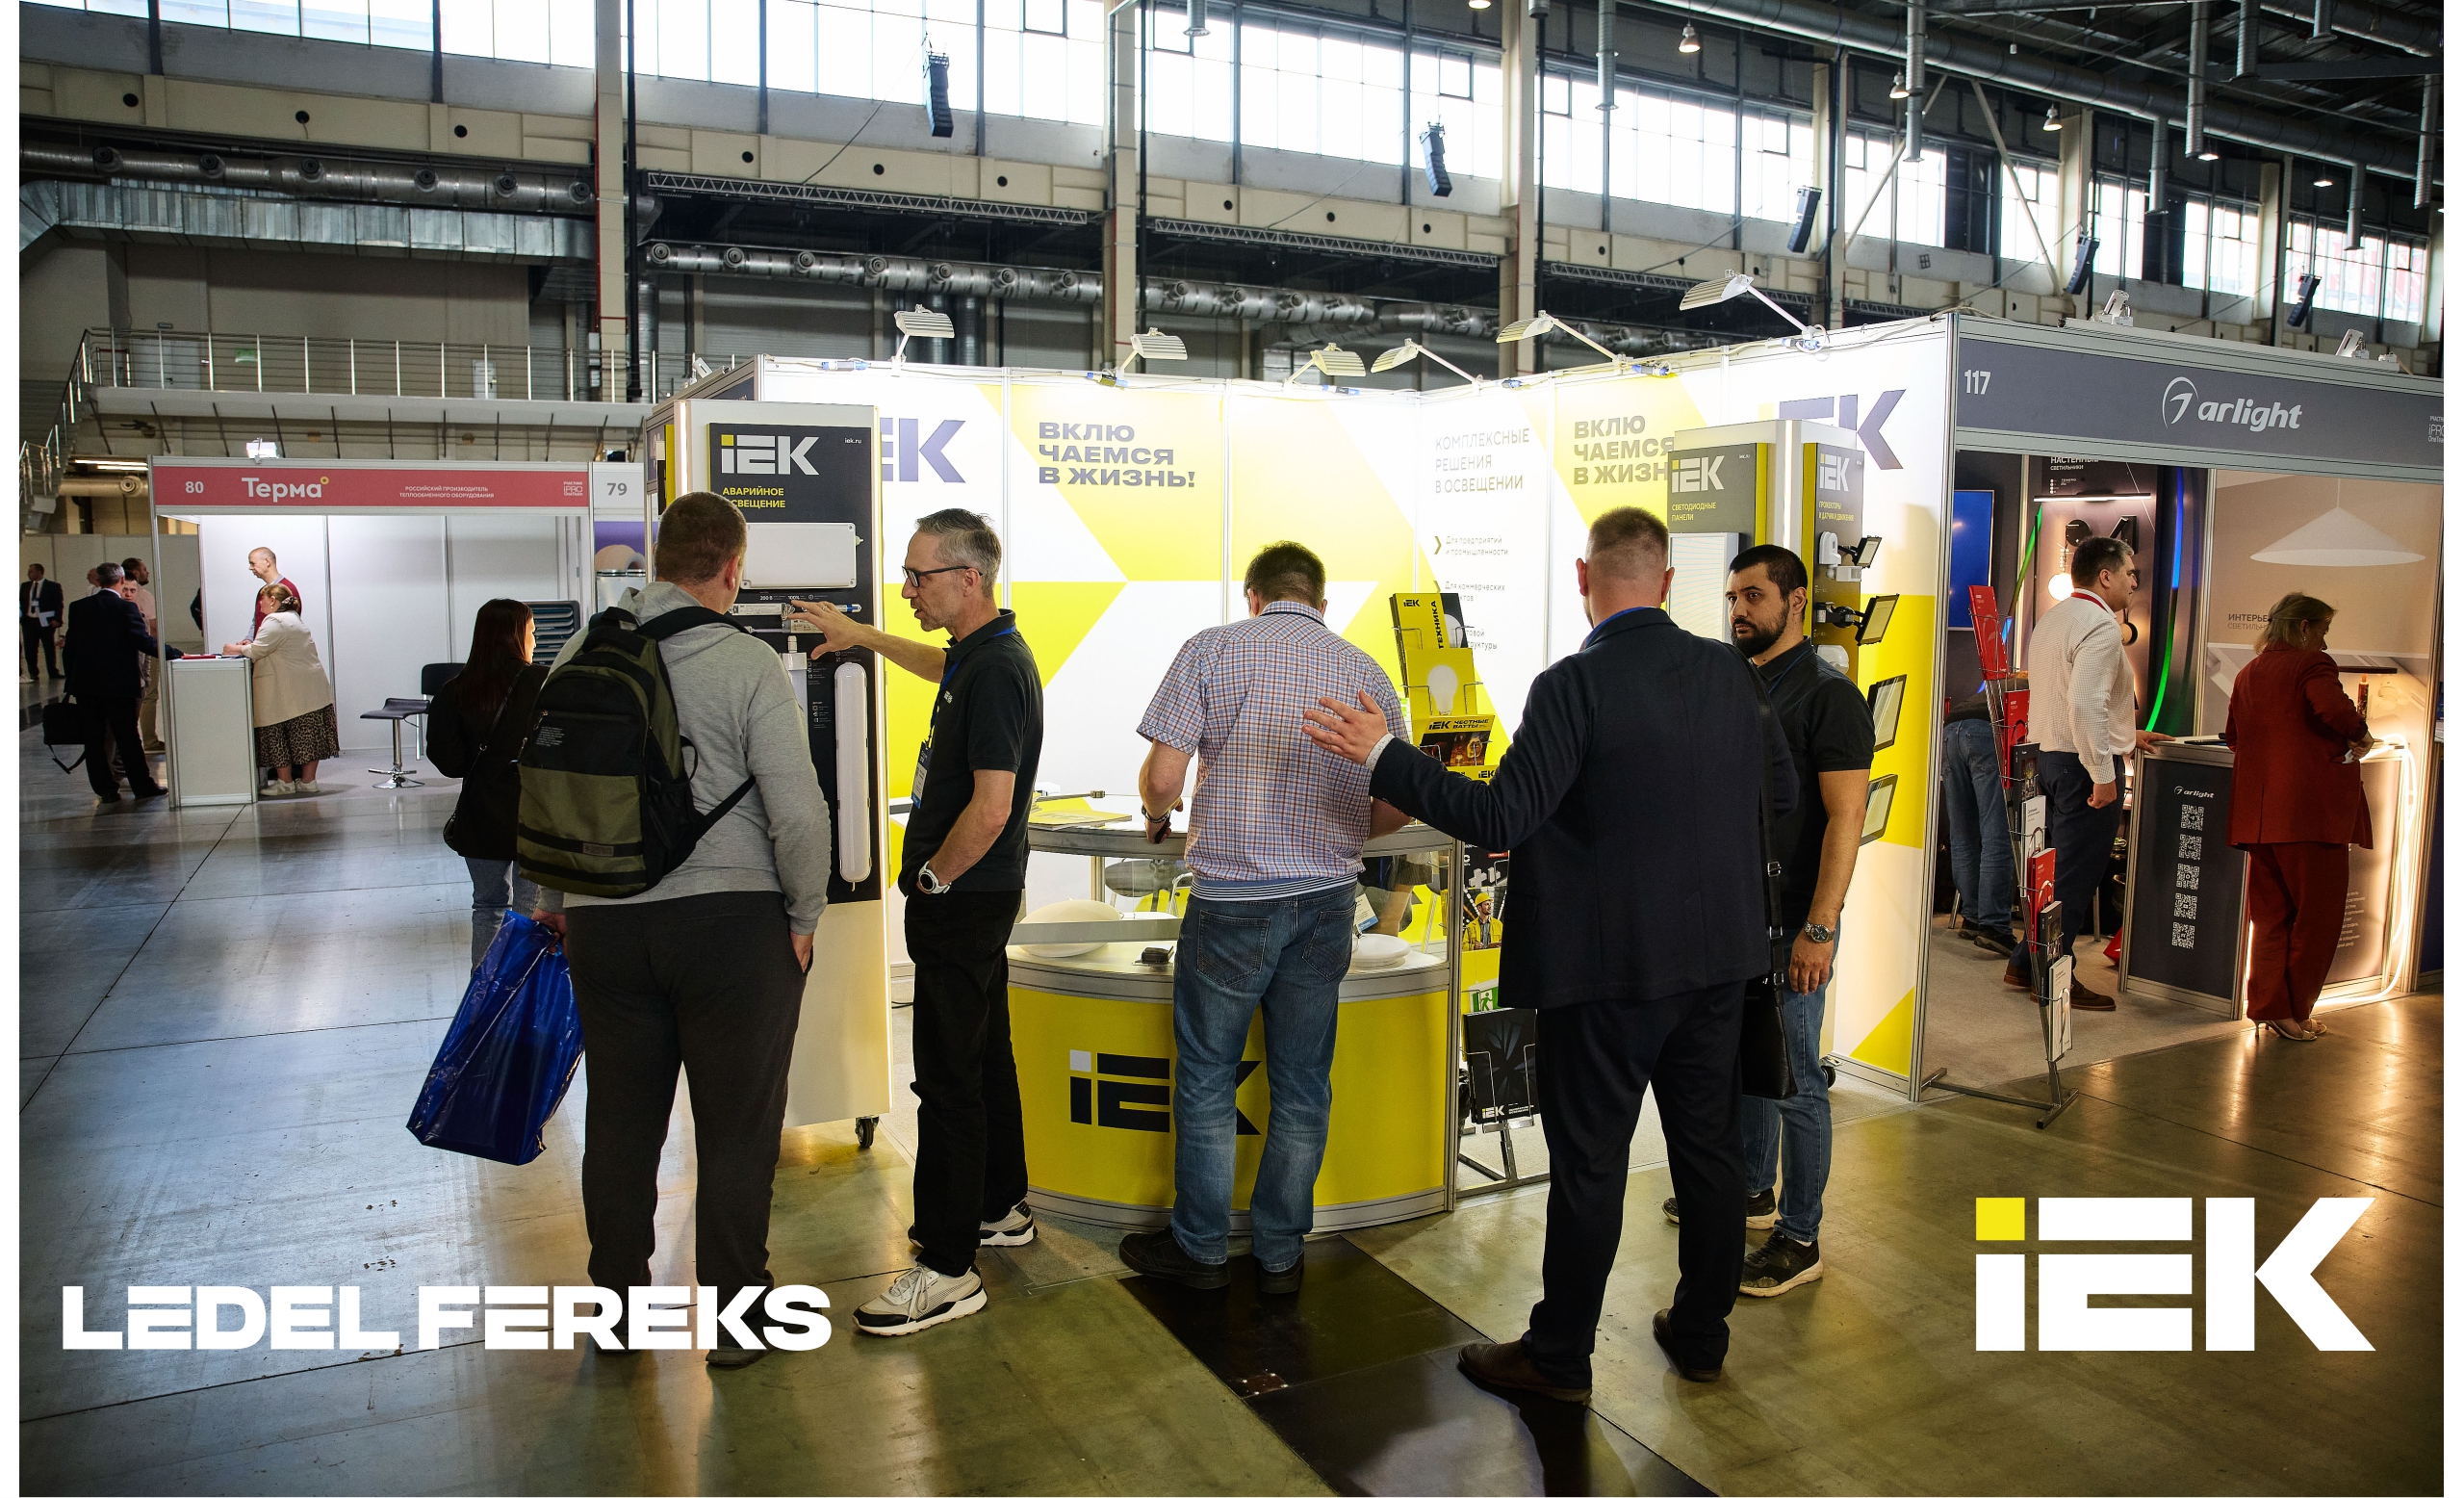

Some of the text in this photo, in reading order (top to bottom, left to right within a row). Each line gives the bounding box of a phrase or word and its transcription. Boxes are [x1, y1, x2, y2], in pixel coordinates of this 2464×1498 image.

[1964, 369, 1991, 395] 117
[2198, 398, 2303, 432] arlight
[1039, 422, 1135, 443] ВКЛЮ
[1574, 415, 1646, 439] ВКЛЮ
[1435, 427, 1530, 452] КОМПЛЕКСНЫЕ
[1573, 436, 1675, 462] ЧАЕМСЯ
[721, 434, 820, 476] iEK
[1039, 444, 1174, 466] ЧАЕМСЯ
[1435, 454, 1492, 473] РЕШЕНИЯ
[1039, 466, 1195, 488] В ЖИЗНЬ!
[1573, 461, 1669, 485] В ЖИЗН
[1671, 454, 1726, 494] iEK
[1819, 452, 1851, 492] iEK
[185, 480, 204, 494] 80
[241, 477, 323, 503] Терма
[606, 482, 628, 496] 79
[722, 485, 784, 497] АВАРИЙНОЕ
[1435, 475, 1524, 494] В ОСВЕЩЕНИИ
[731, 499, 786, 509] СВЕЩЕНИЕ
[1671, 502, 1717, 512] СВЕТОДИОДНЫЕ
[1671, 513, 1694, 522] ПАНЕЛИ
[1459, 535, 1502, 546] предприятий
[1450, 549, 1508, 557] промышленности
[1458, 583, 1505, 592] коммерческих
[1402, 599, 1421, 607] iEK
[1430, 600, 1445, 650] ТЕХНИКА
[2227, 622, 2267, 631] СВЕТИЛЬН
[2228, 613, 2268, 622] ИНТЕРЬЕ
[1428, 720, 1451, 730] iEK
[2183, 788, 2215, 799] arlight
[1068, 1048, 1263, 1136] iE
[1481, 1104, 1505, 1119] iEK
